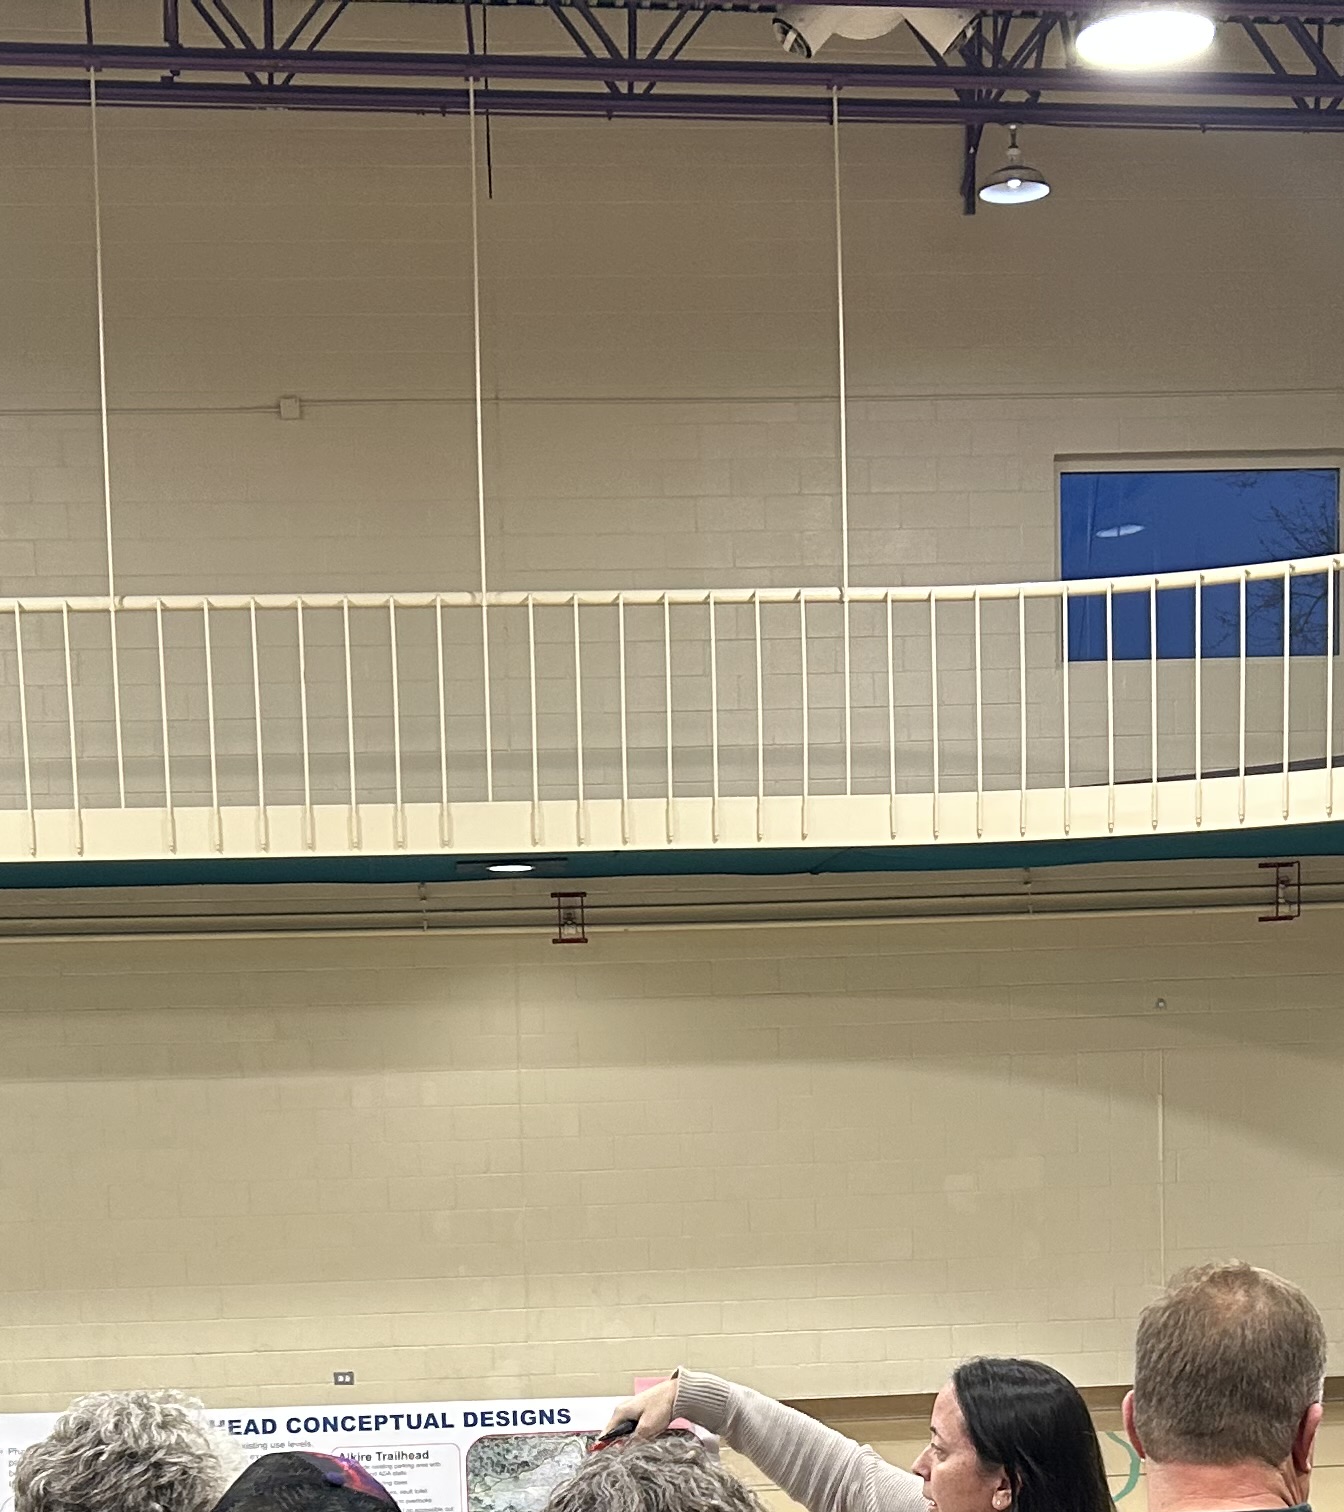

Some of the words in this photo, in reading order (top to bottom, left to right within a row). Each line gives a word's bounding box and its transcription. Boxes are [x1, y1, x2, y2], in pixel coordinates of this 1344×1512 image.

[286, 1412, 455, 1434] CONCEPTUAL
[463, 1408, 572, 1428] DESIGNS
[375, 1449, 430, 1461] Trailhead
